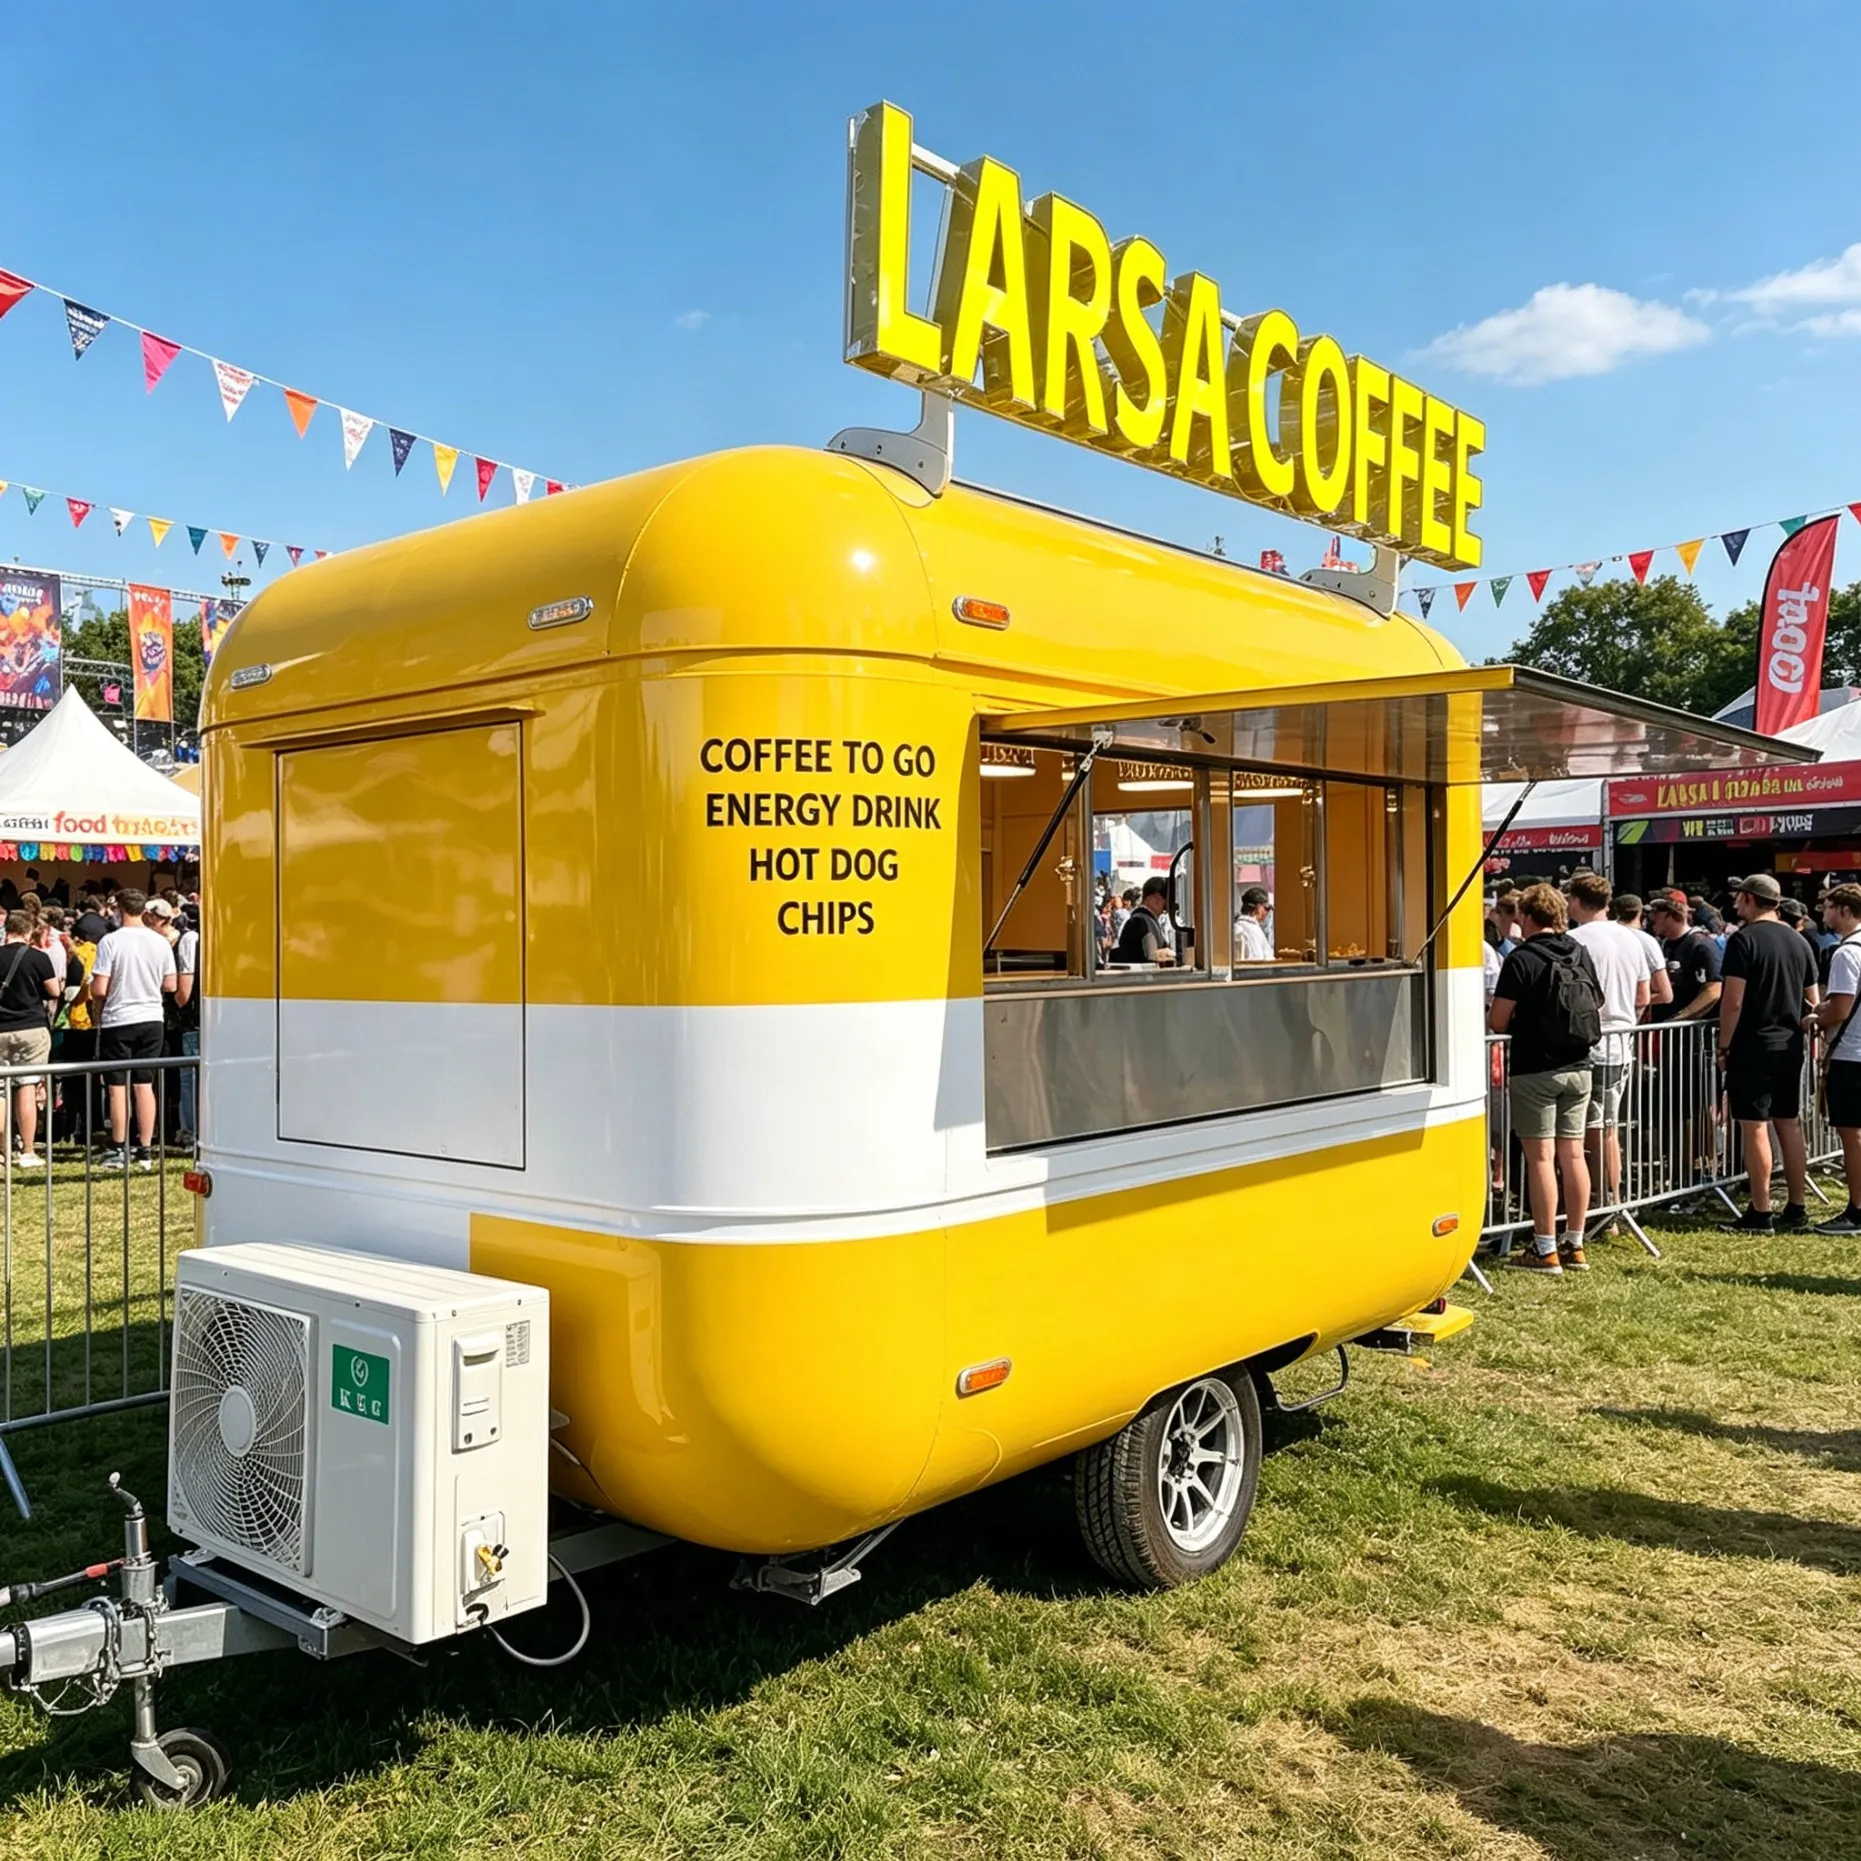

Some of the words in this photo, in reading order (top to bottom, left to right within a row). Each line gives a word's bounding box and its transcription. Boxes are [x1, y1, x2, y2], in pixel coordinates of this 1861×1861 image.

[876, 100, 1232, 479] LARSA
[1247, 308, 1487, 570] COFFEE
[700, 738, 833, 773] COFFEE
[842, 740, 884, 774] TO
[893, 743, 936, 778] GO
[53, 810, 107, 834] food
[706, 793, 842, 827] ENERGY
[852, 794, 942, 829] DRINK
[750, 847, 820, 881] HOT
[830, 848, 899, 881] DOG
[776, 900, 875, 935] CHIPS
